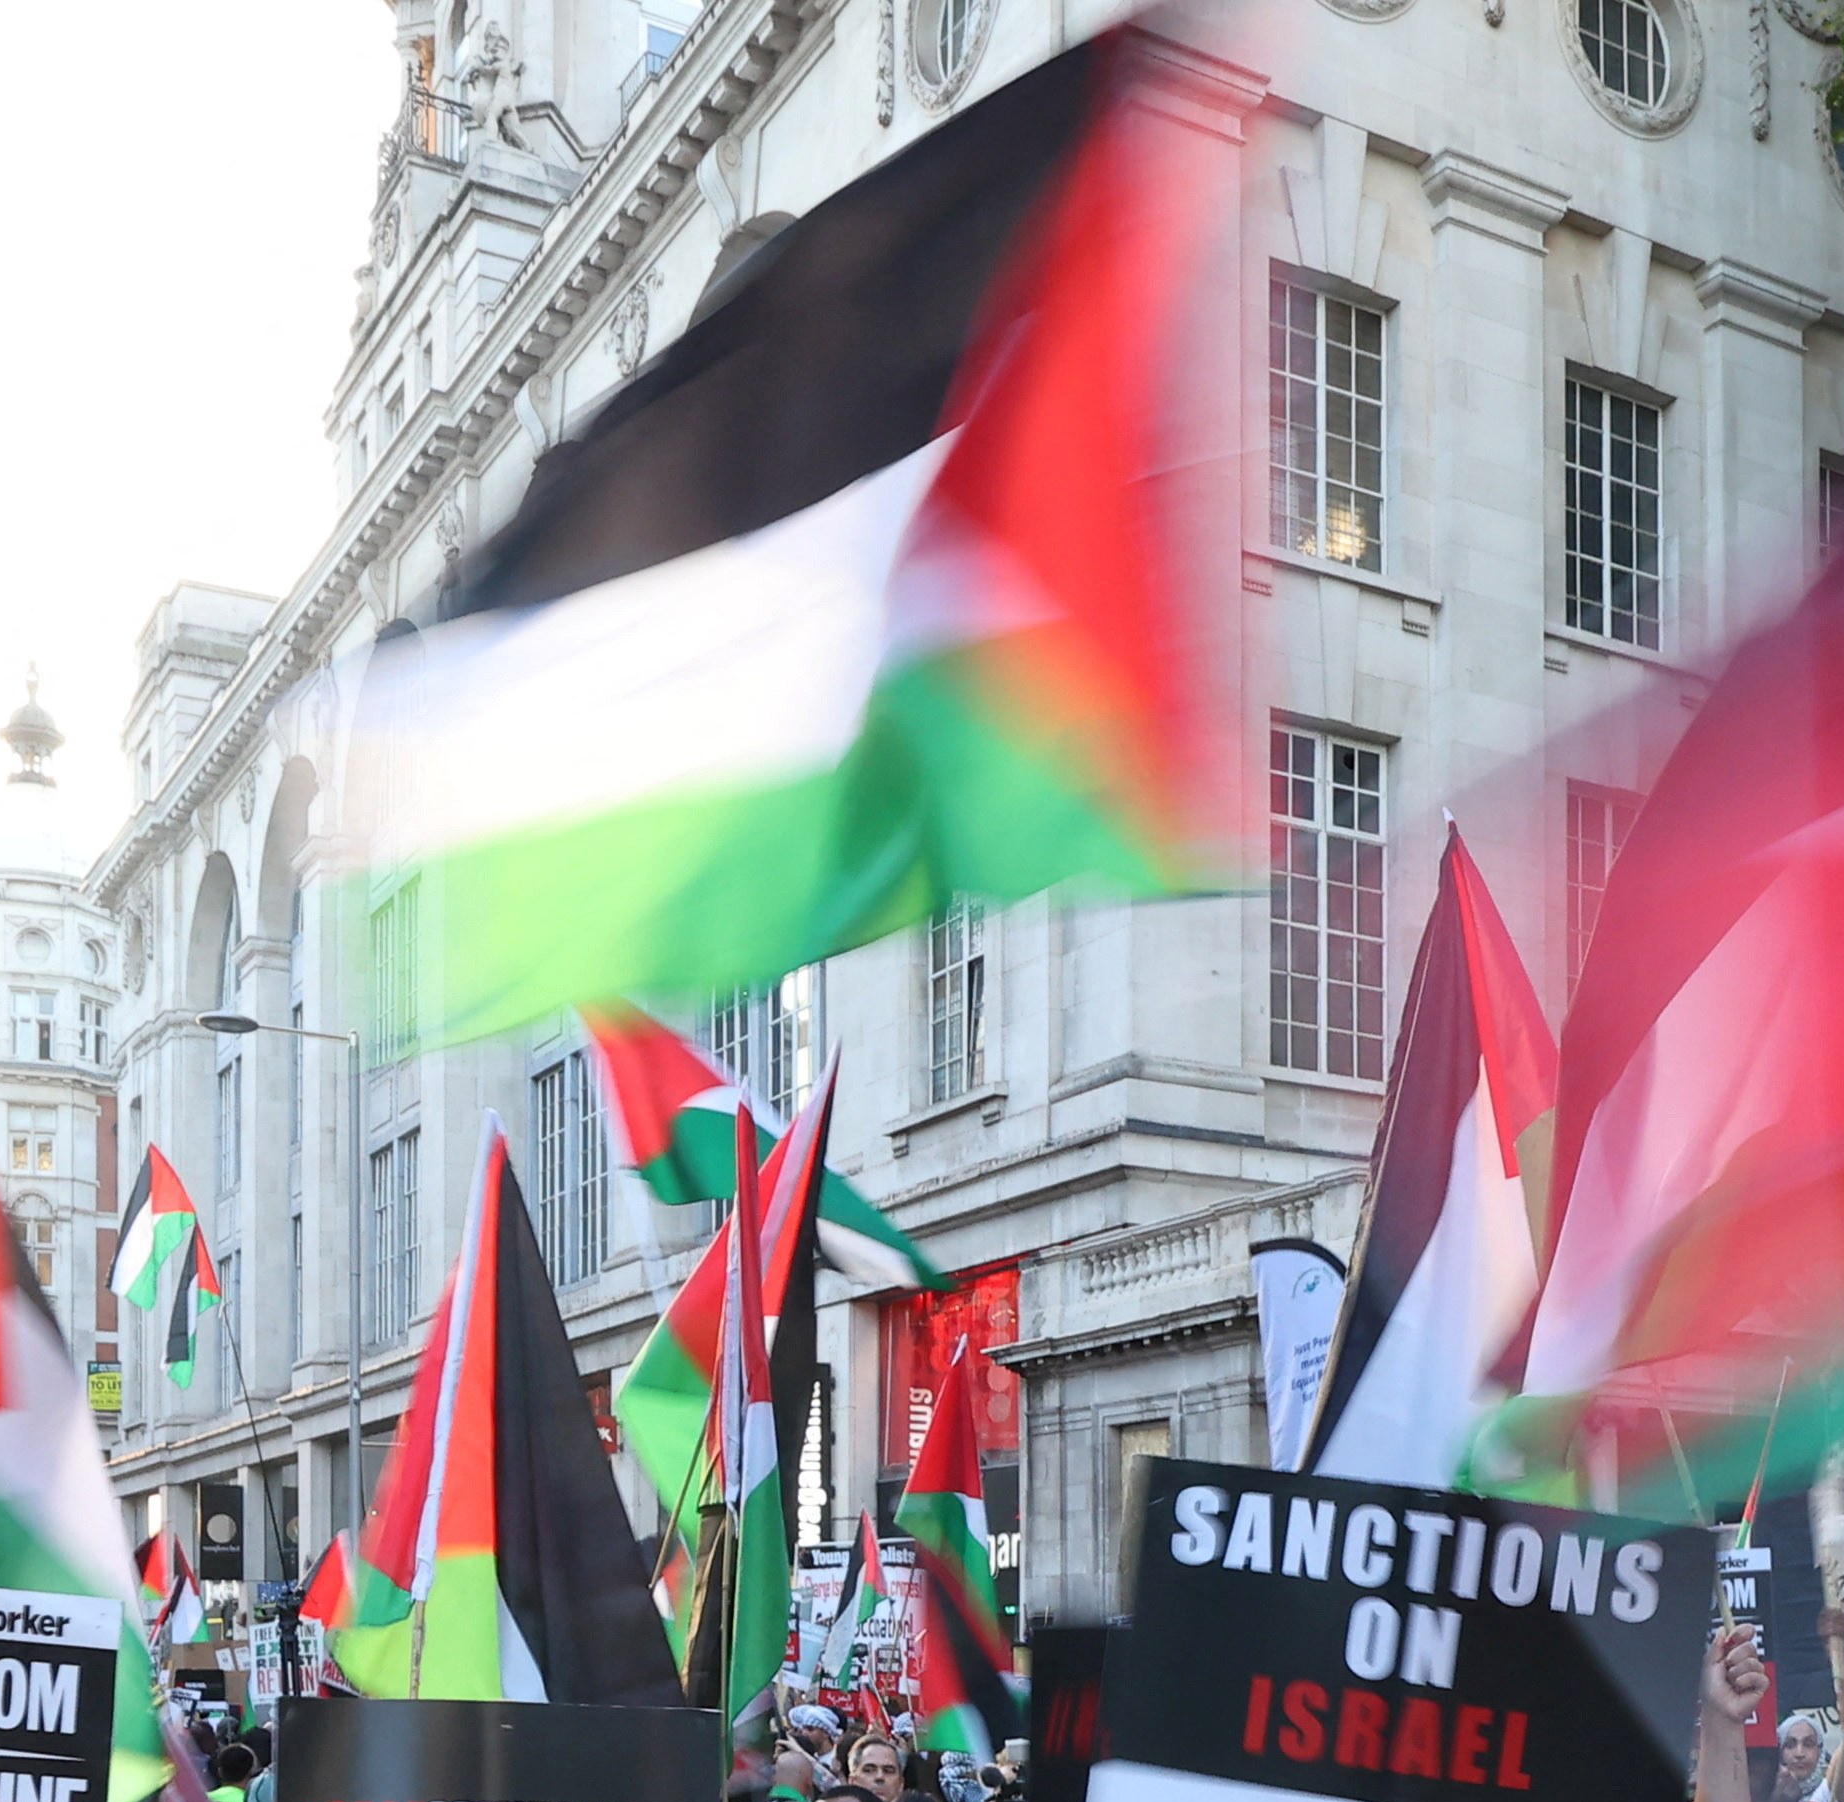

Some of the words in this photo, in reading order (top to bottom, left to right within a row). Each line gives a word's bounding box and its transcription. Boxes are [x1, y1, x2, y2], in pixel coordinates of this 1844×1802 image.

[91, 1380, 105, 1391] TO
[107, 1380, 122, 1391] LET
[797, 1380, 828, 1547] wagamama
[812, 1550, 850, 1566] Young
[879, 1547, 915, 1564] alists
[1170, 1483, 1664, 1626] SANCTIONS
[1715, 1555, 1749, 1570] orker
[254, 1626, 273, 1642] FREE
[1343, 1594, 1463, 1691] ON
[1243, 1674, 1532, 1791] ISRAEL
